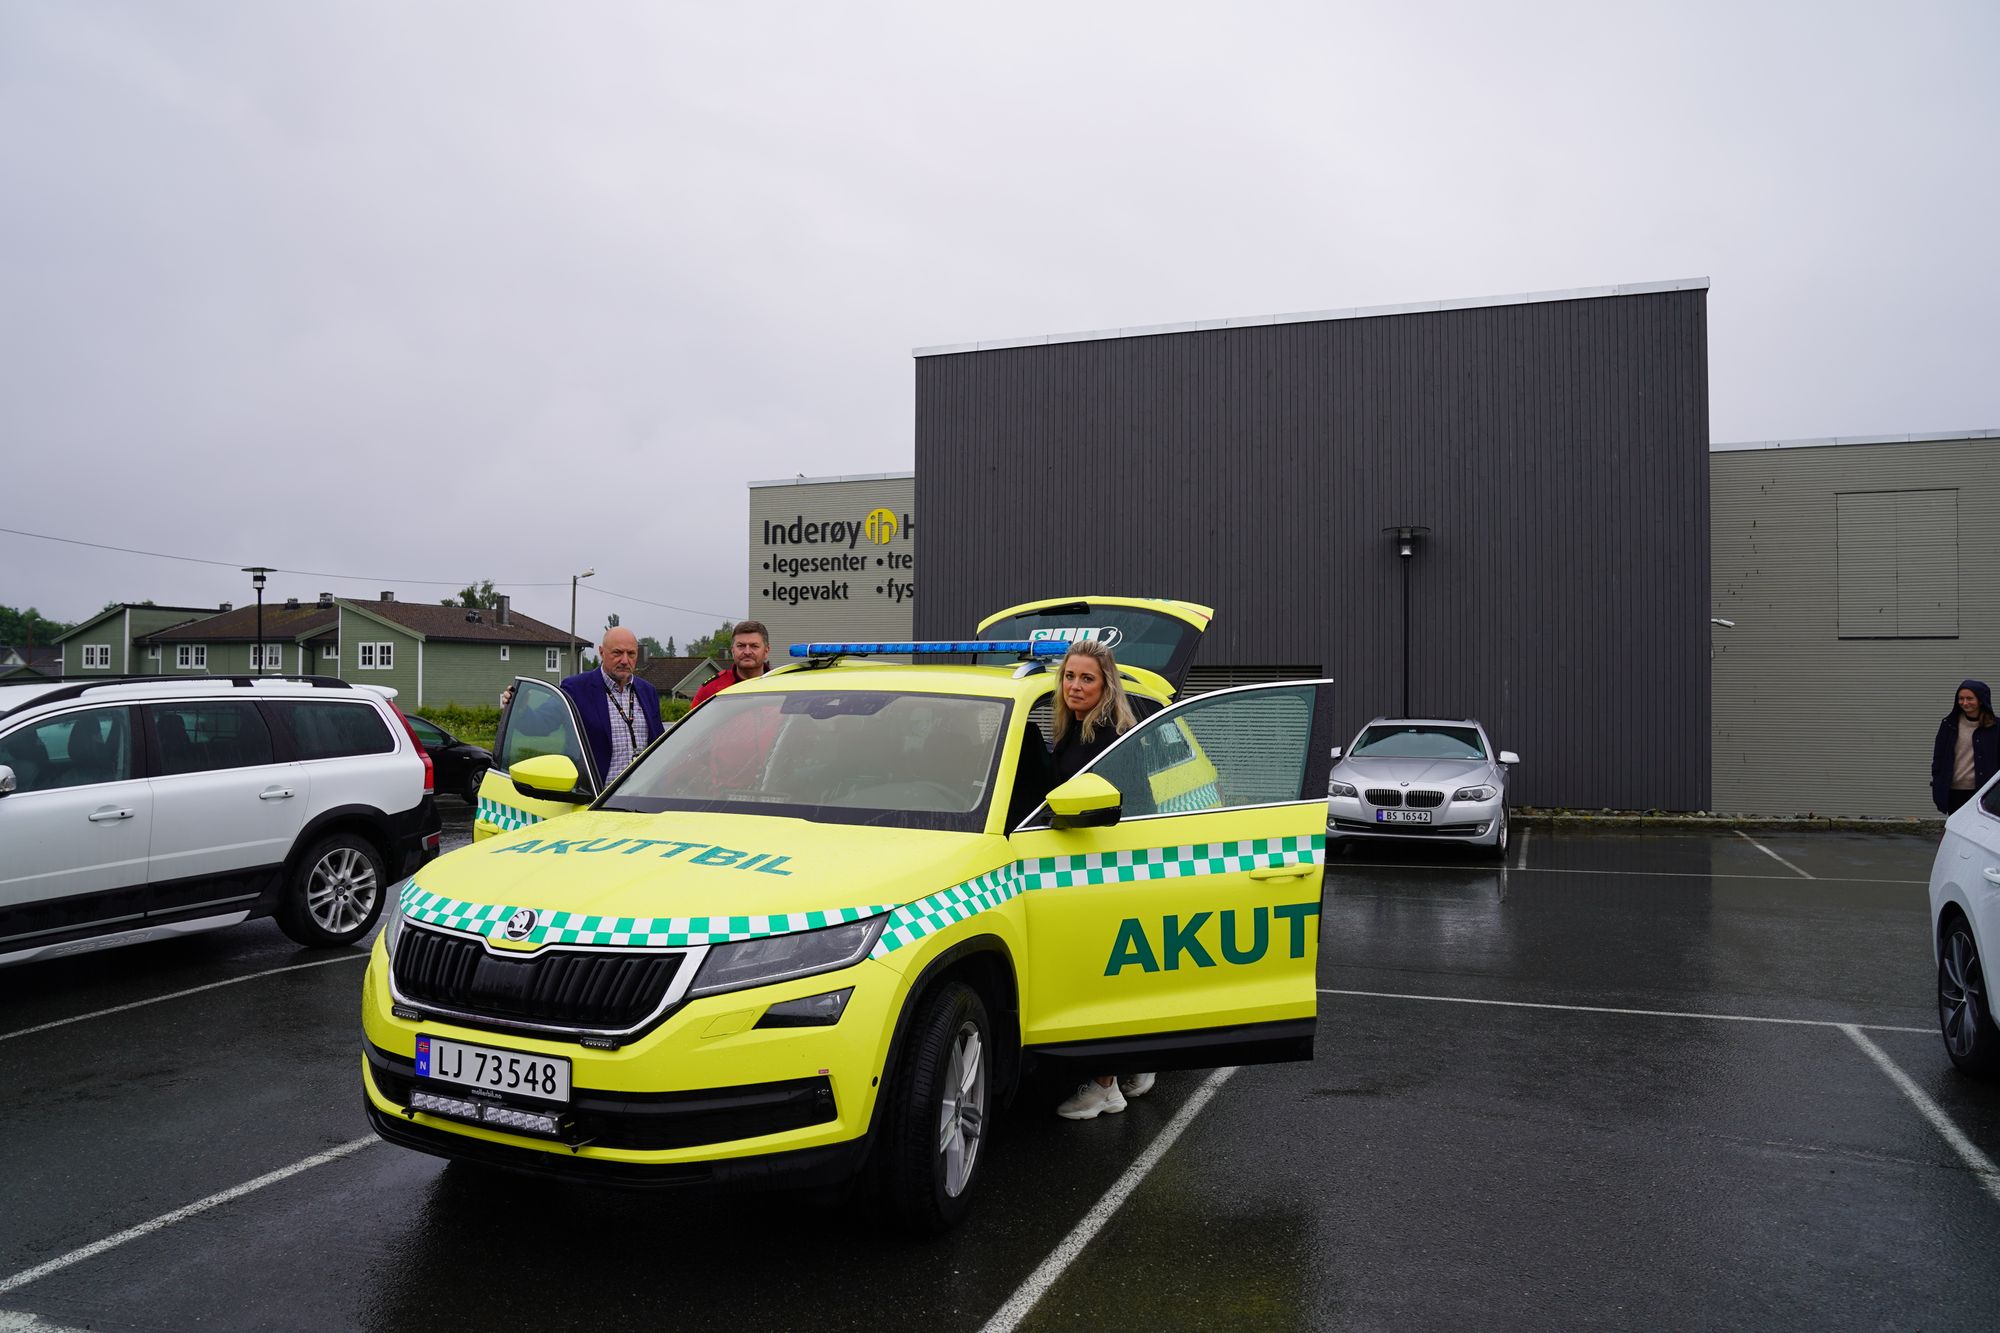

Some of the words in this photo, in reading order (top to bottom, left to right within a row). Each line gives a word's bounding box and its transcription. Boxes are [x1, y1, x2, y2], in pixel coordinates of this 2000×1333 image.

[764, 516, 861, 549] Inderøy
[773, 554, 867, 577] legesenter
[888, 552, 912, 569] tre
[773, 580, 848, 605] legevakt
[888, 578, 913, 603] fys
[1387, 812, 1397, 820] BS
[1403, 812, 1428, 821] 16542
[490, 837, 793, 876] AKUTTBIL
[1104, 902, 1320, 976] AKUT
[419, 1061, 427, 1070] N
[438, 1046, 462, 1078] LJ
[474, 1053, 556, 1094] 73548
